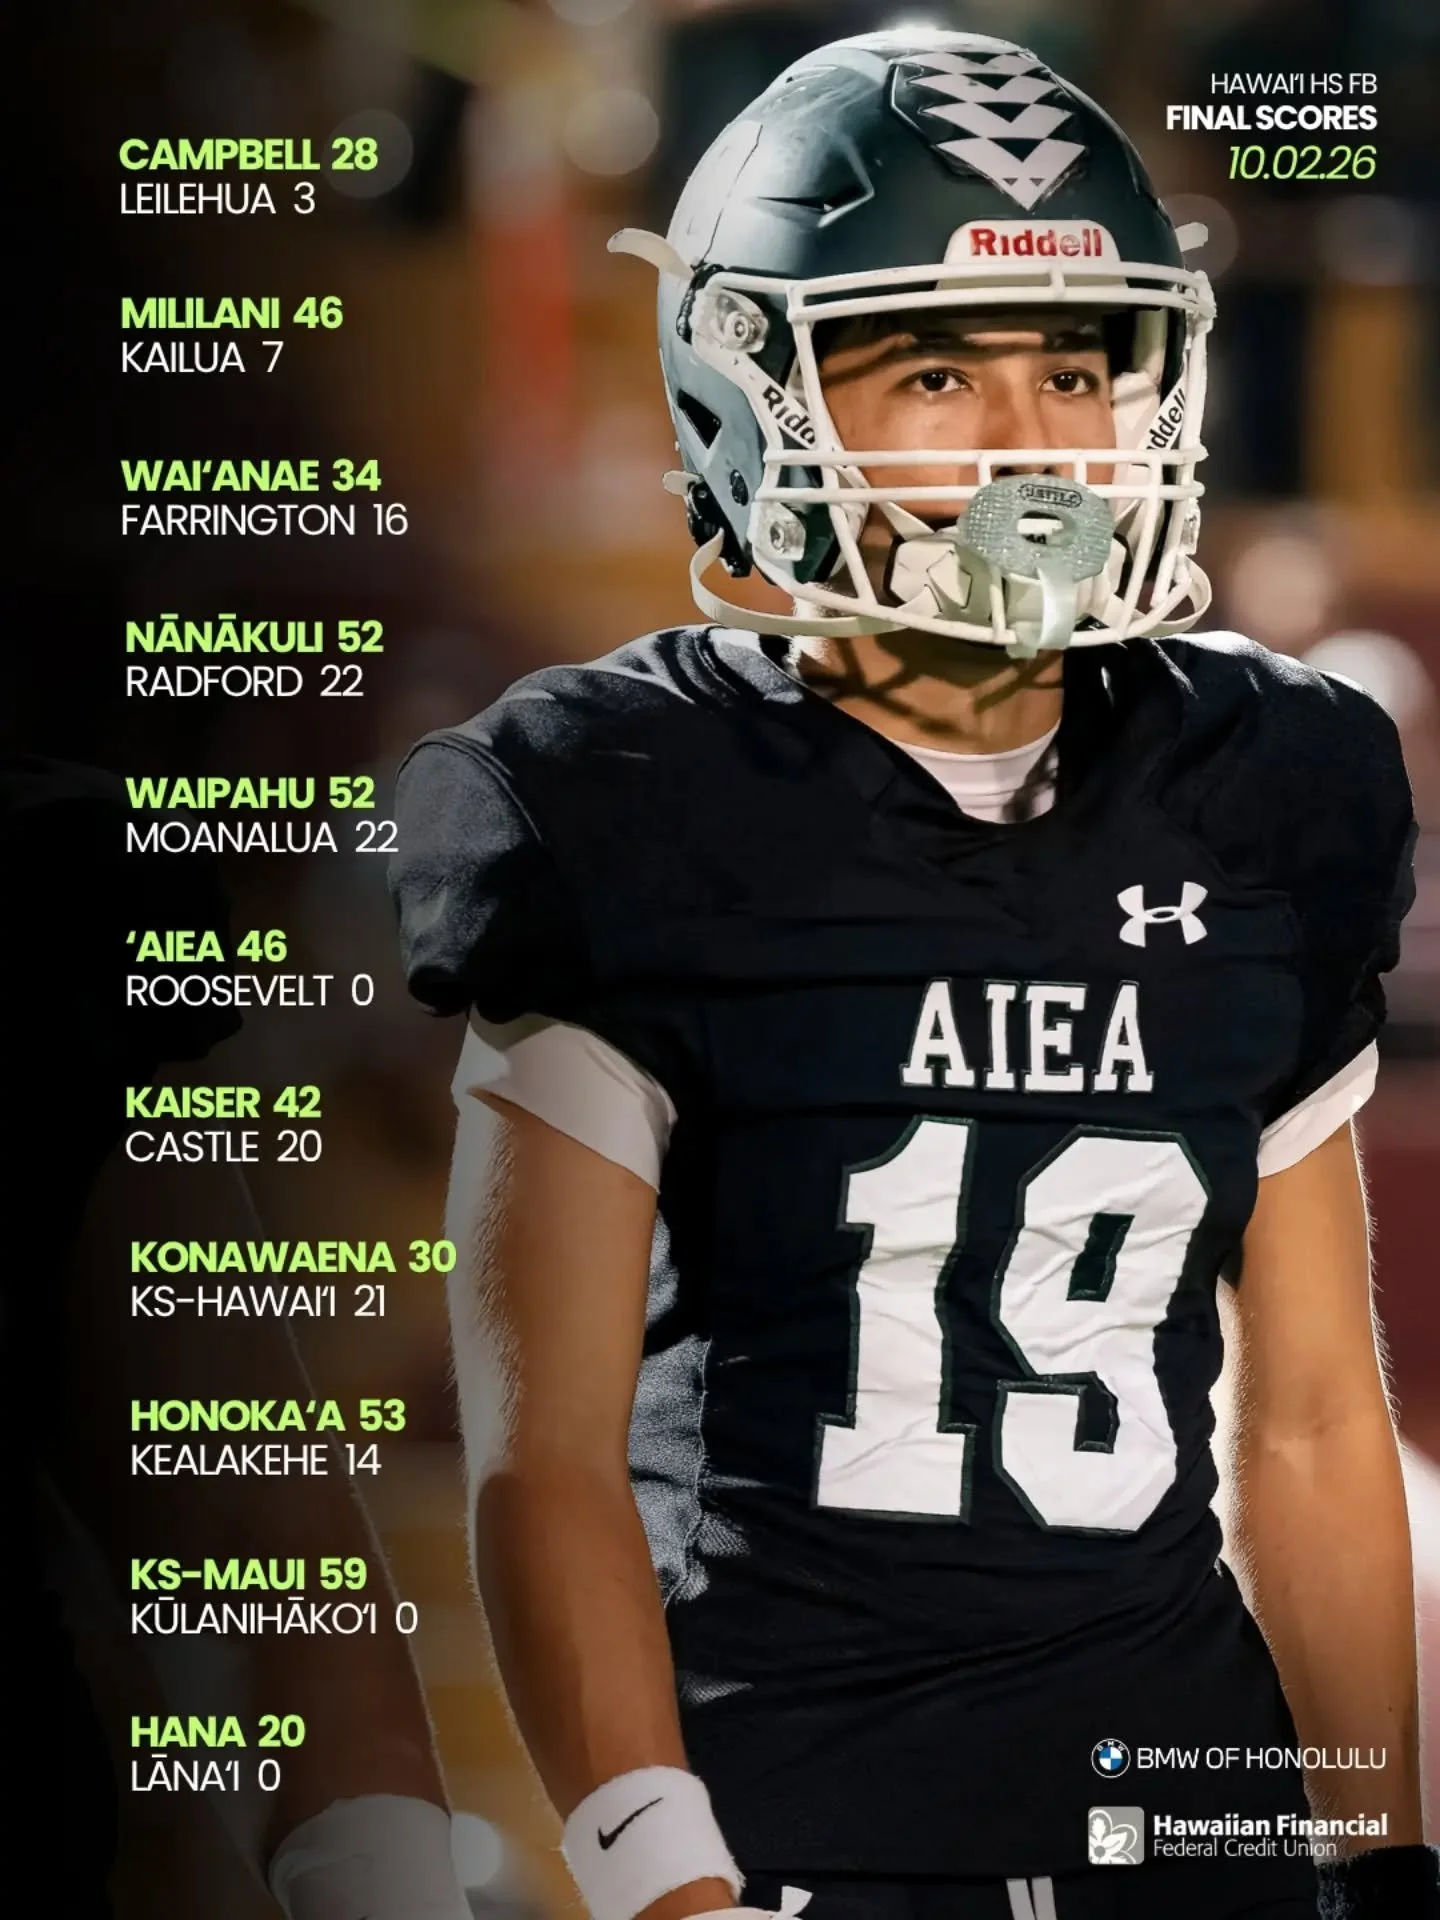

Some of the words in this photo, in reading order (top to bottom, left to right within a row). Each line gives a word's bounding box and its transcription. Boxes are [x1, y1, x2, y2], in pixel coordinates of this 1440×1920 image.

[969, 228, 1102, 257] Riddell
[900, 978, 1155, 1093] AIEA
[811, 1115, 1211, 1538] 19
